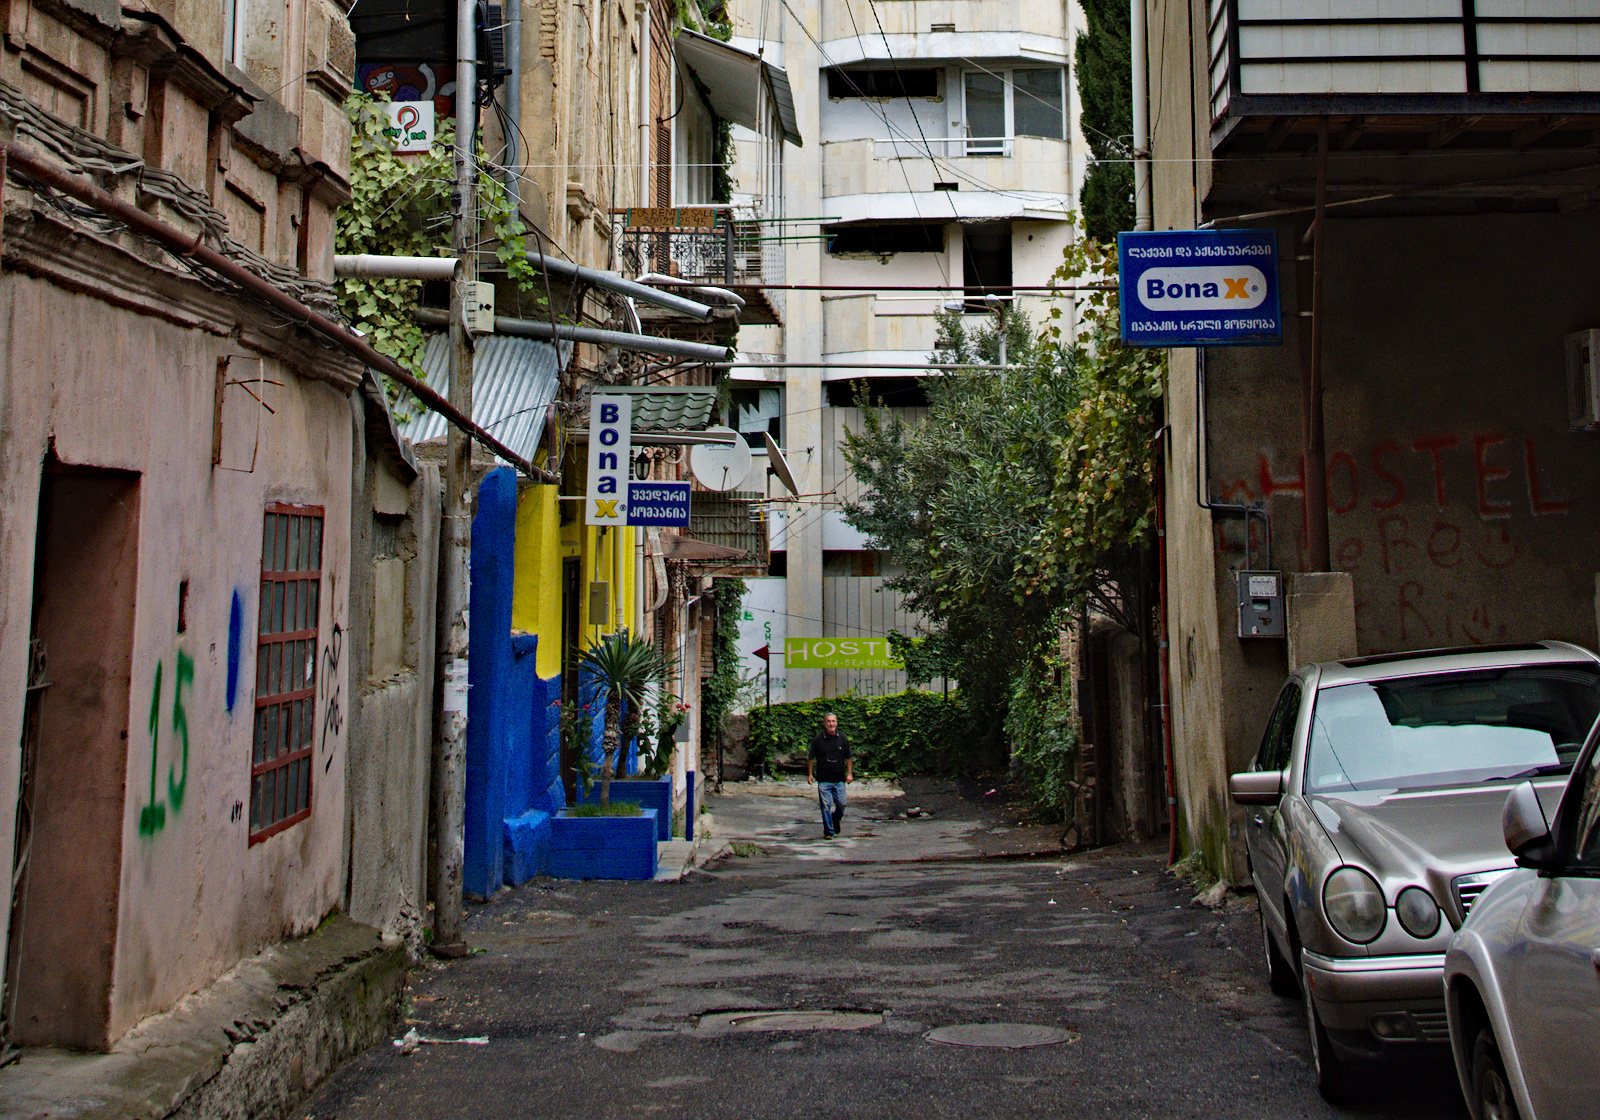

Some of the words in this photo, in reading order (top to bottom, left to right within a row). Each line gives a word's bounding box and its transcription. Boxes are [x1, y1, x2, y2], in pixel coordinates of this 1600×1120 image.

[631, 208, 648, 218] FOR
[651, 208, 677, 217] RENT
[679, 208, 689, 216] OR
[691, 208, 714, 217] SALE
[679, 216, 690, 226] 25
[693, 216, 706, 226] 45
[1128, 247, 1173, 258] ლაქები
[1175, 247, 1192, 257] და
[1195, 245, 1272, 257] აქსესუარები
[1131, 321, 1178, 332] იატაკის
[1180, 319, 1222, 331] სრული
[1224, 319, 1276, 330] მოწყობა
[1258, 431, 1574, 548] HOSTEL
[631, 490, 687, 502] შვედური
[630, 507, 687, 519] კომპანია
[138, 648, 195, 837] 15
